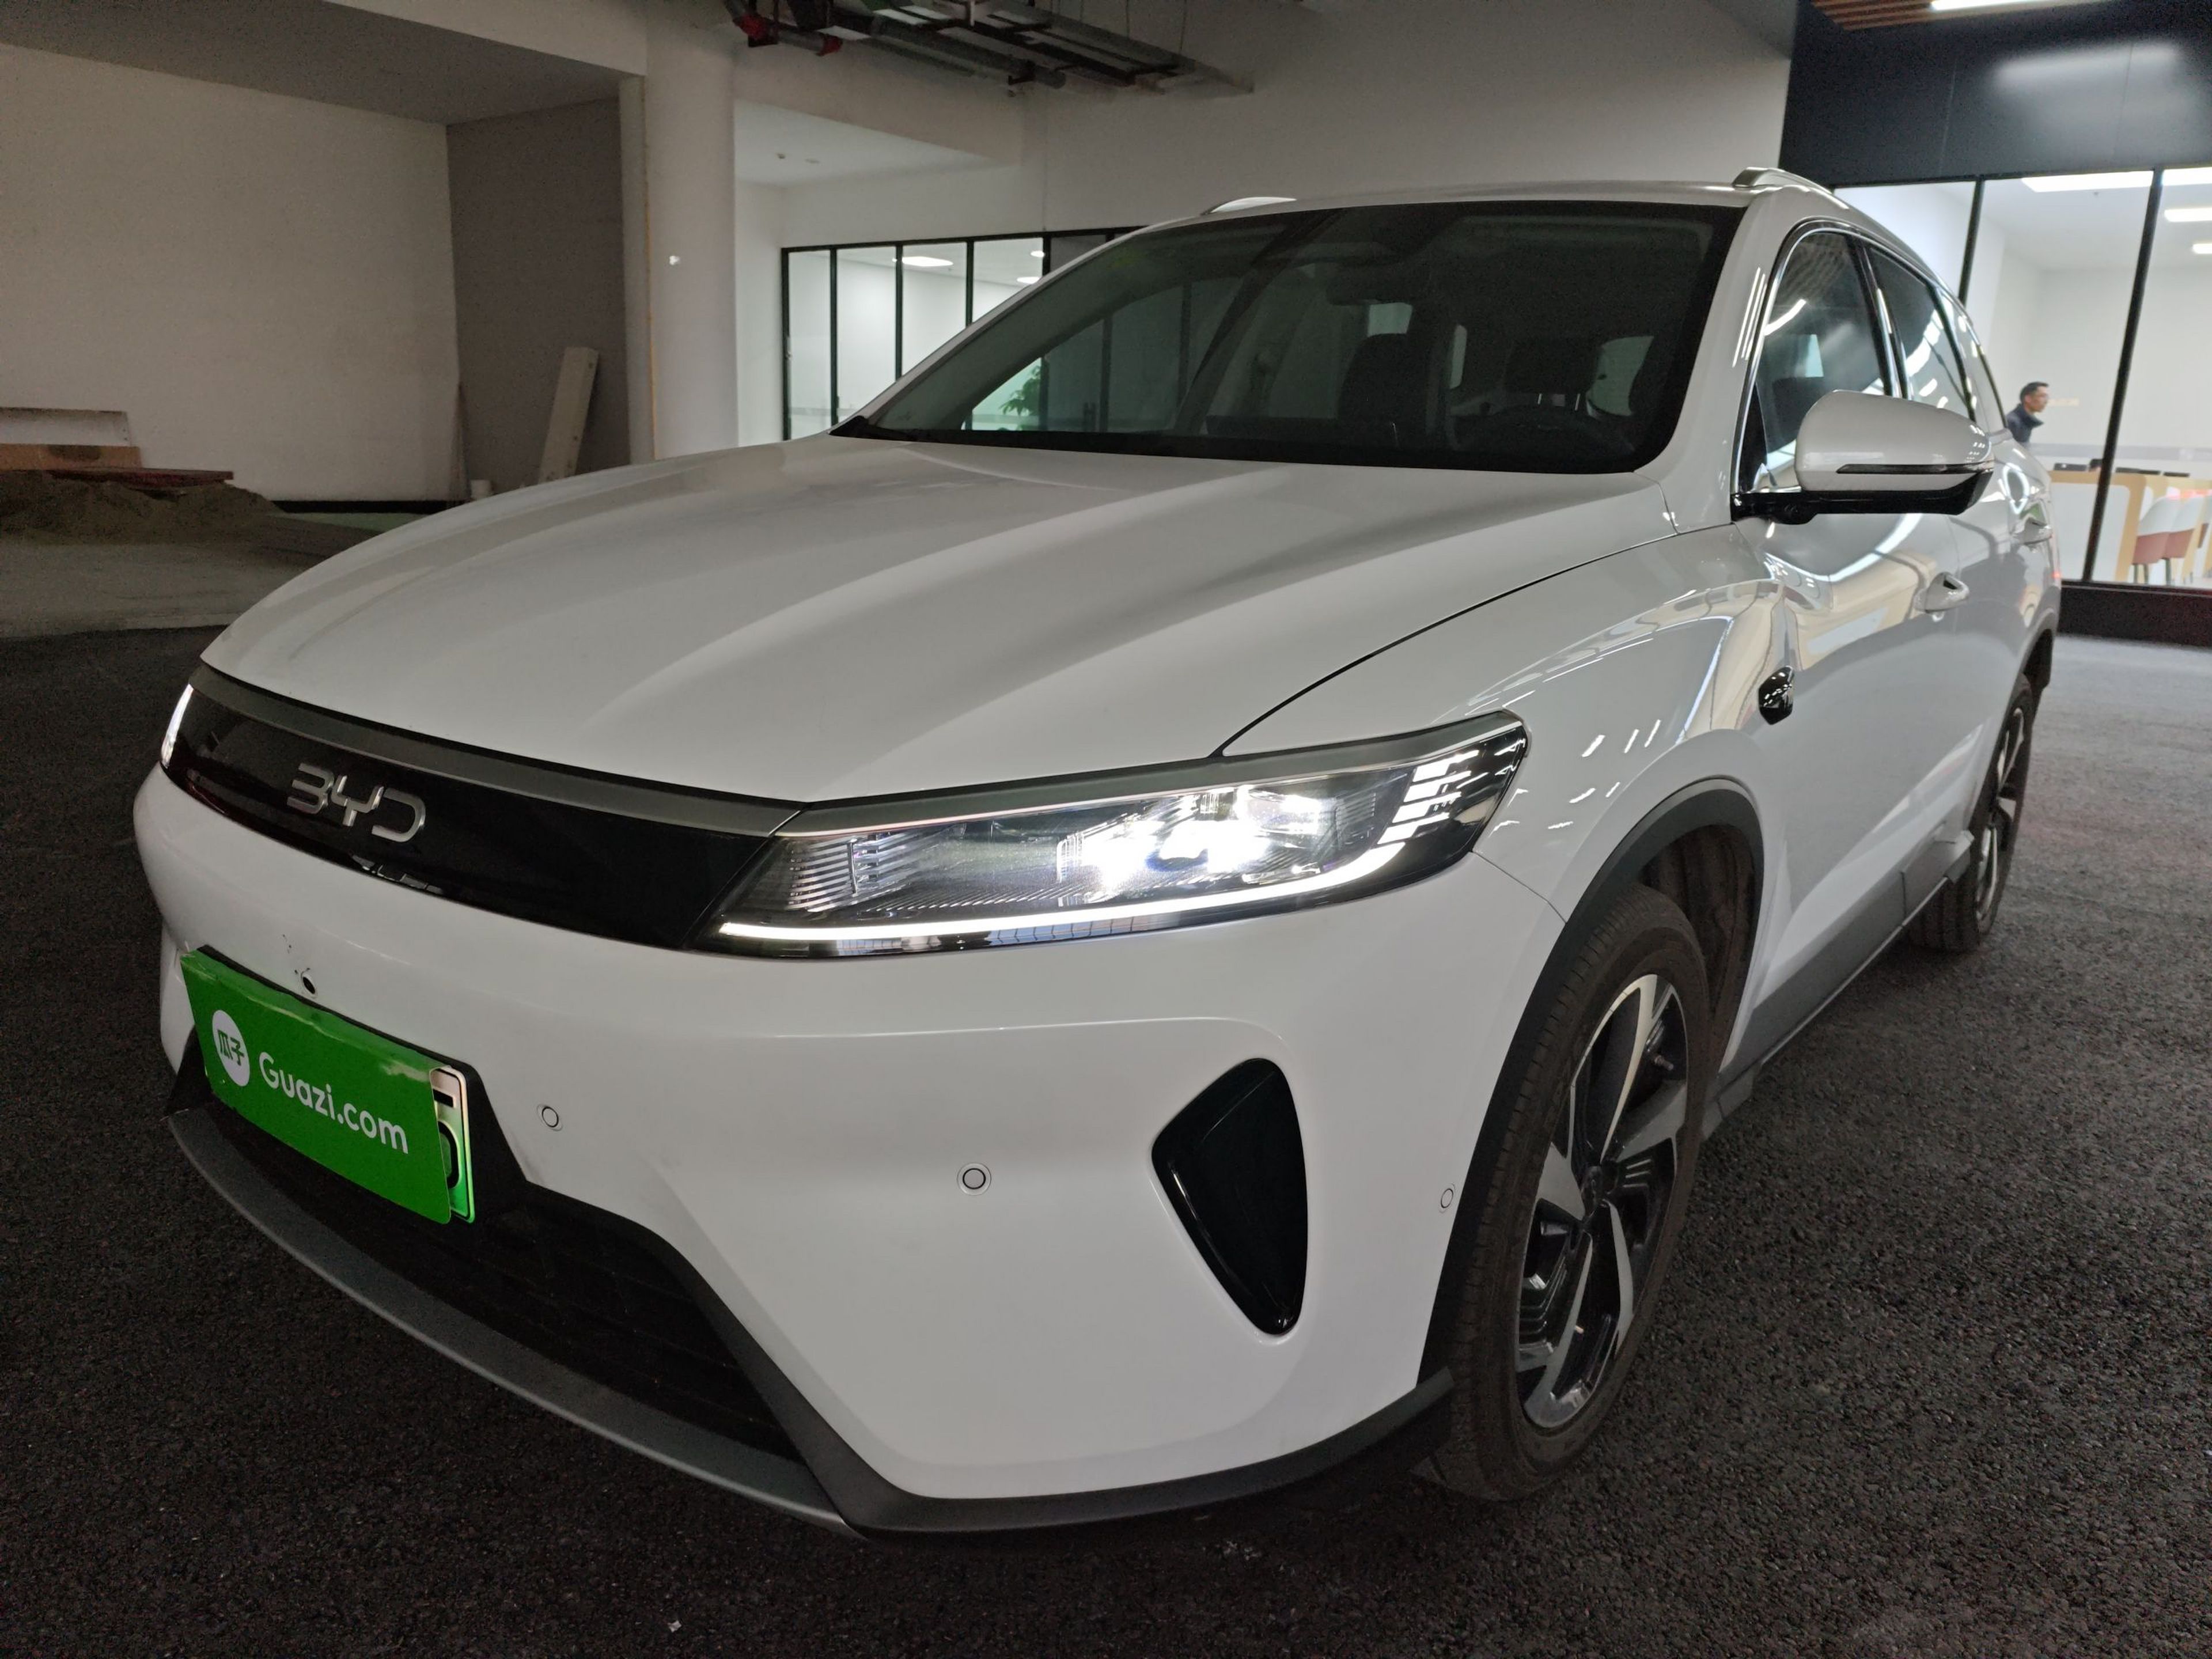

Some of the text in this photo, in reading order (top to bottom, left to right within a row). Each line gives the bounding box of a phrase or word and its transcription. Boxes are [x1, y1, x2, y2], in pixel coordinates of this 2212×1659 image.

[287, 762, 426, 843] BYD
[217, 1029, 245, 1066] 瓜子
[258, 1051, 408, 1154] Guazi.com
